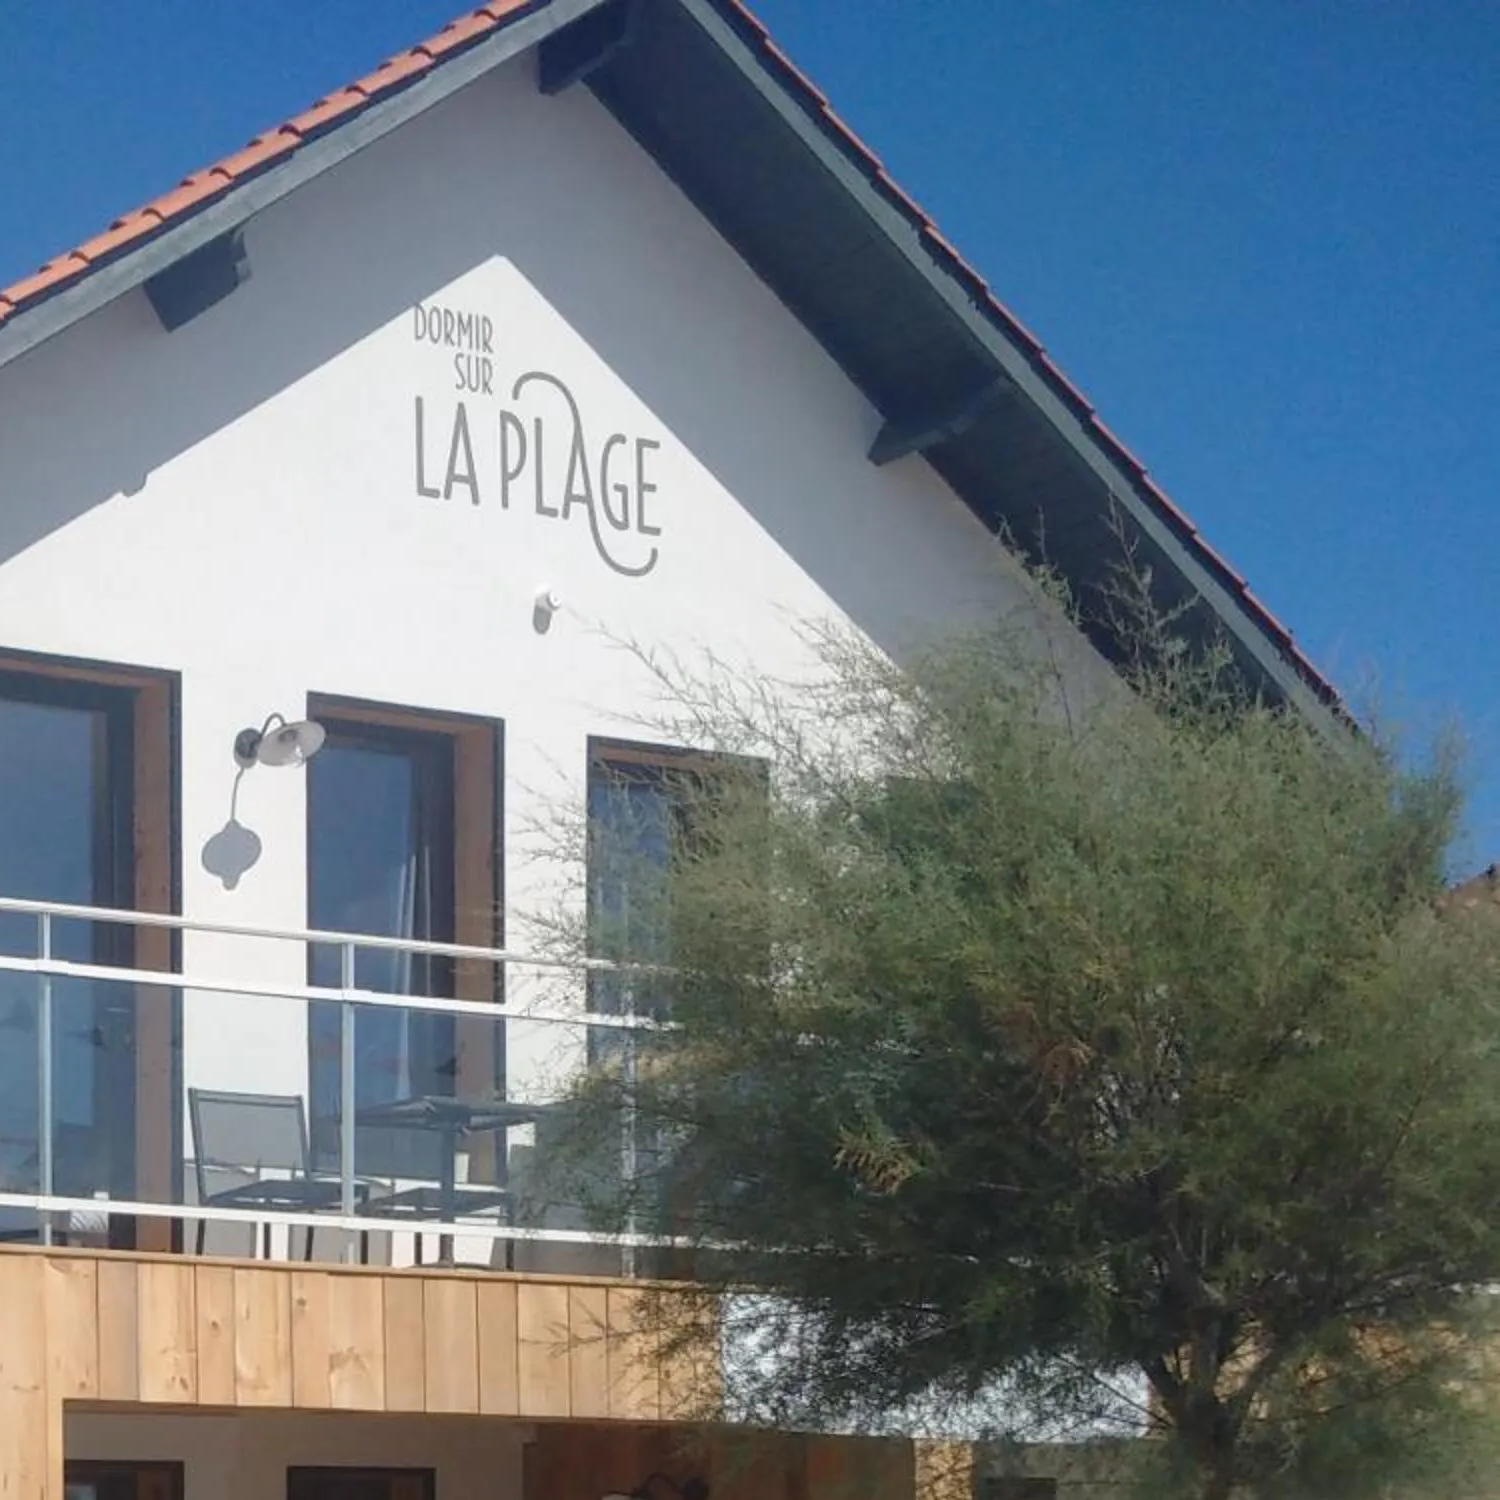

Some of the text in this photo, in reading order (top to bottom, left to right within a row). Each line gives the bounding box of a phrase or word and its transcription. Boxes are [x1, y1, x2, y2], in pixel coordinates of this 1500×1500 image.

[414, 303, 493, 353] DORMIR
[454, 353, 493, 394] SUR
[415, 371, 661, 577] LA PLAGE
